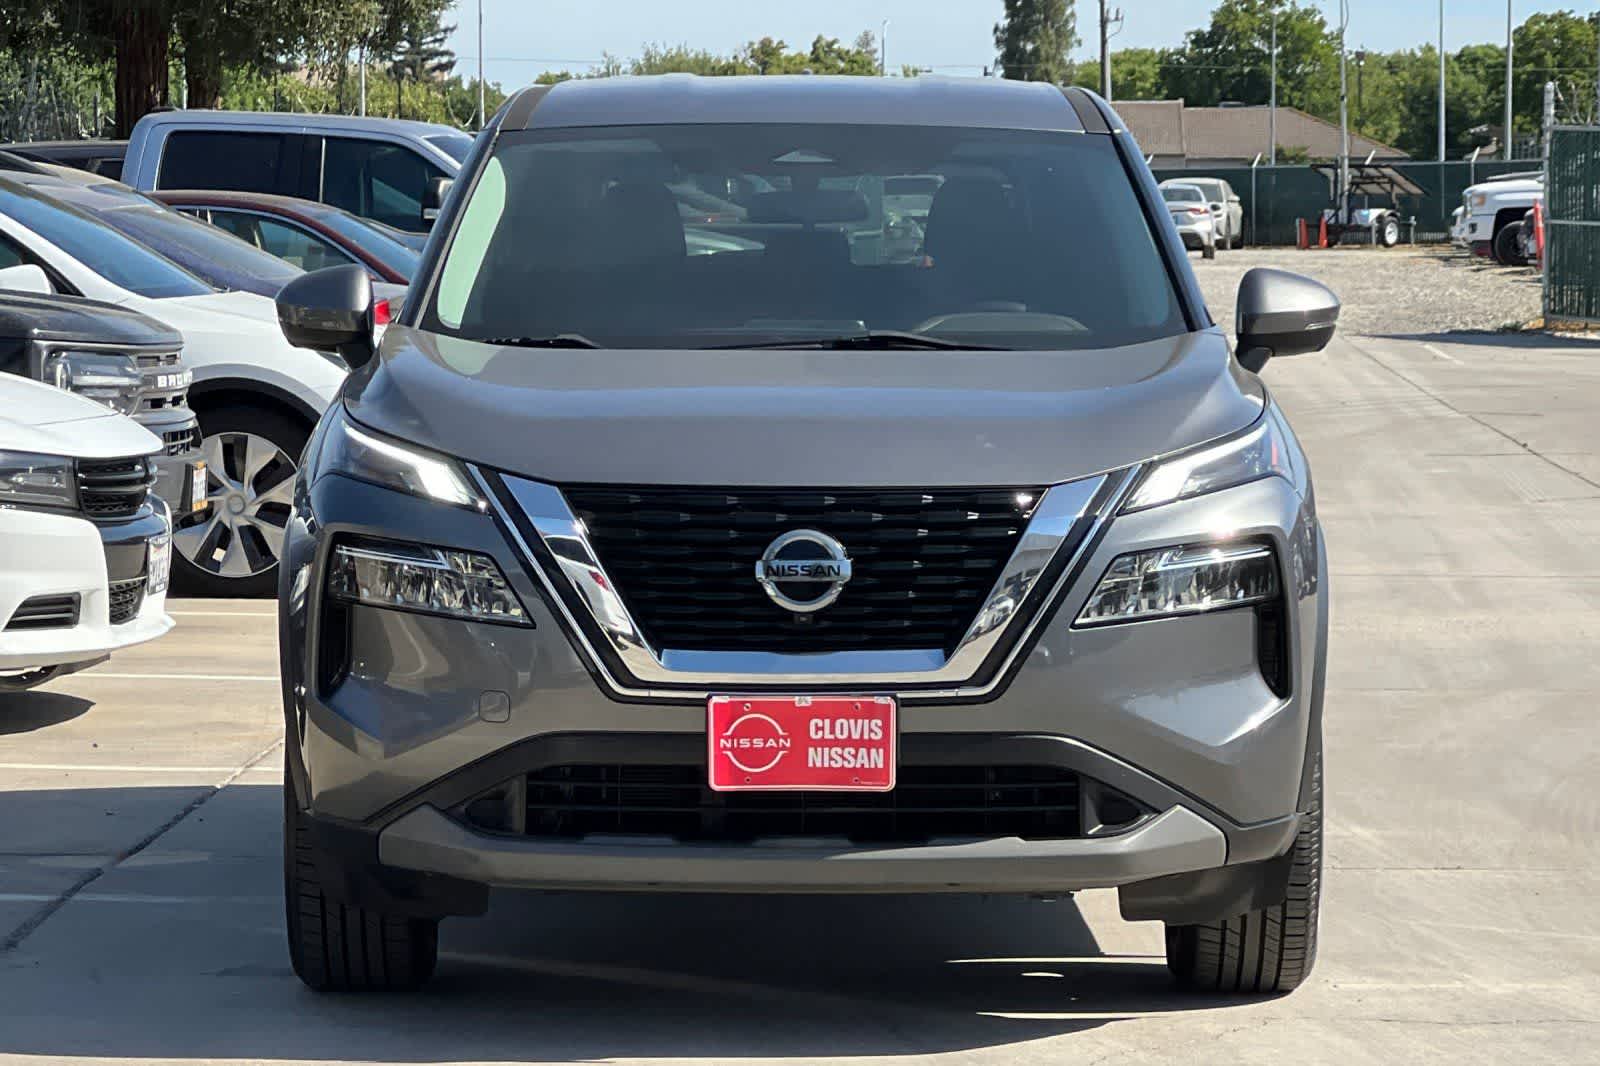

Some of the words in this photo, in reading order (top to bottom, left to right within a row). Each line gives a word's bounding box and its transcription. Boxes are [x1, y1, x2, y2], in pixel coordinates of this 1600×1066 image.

[766, 564, 841, 577] NISSAN
[809, 718, 883, 740] CLOVIS
[719, 738, 791, 748] NISSAN
[807, 747, 884, 769] NISSAN
